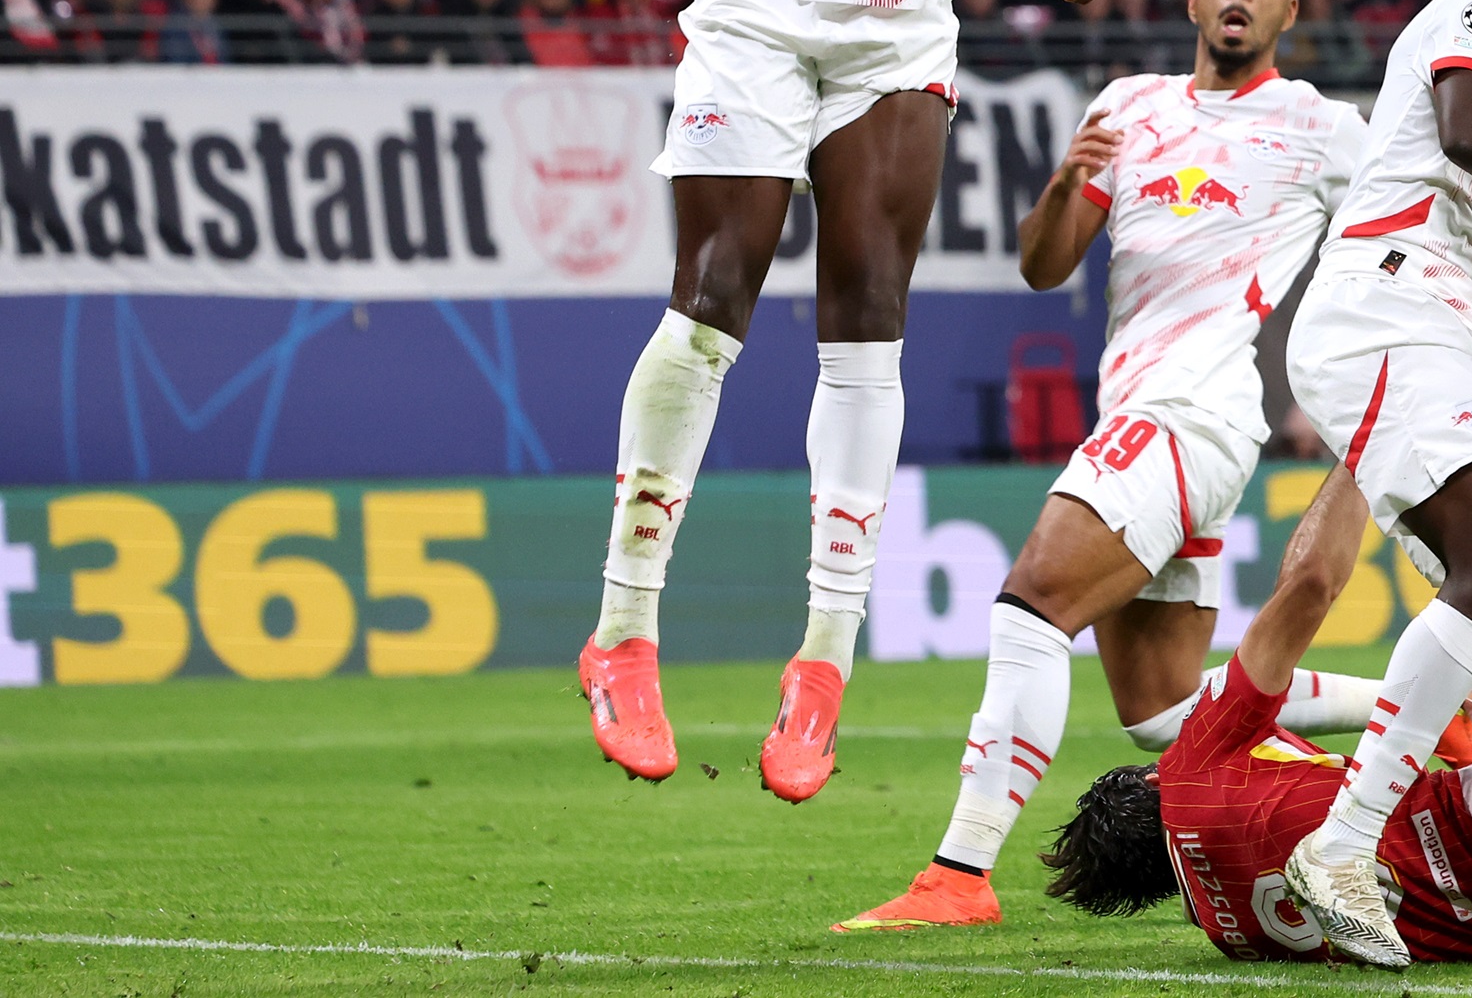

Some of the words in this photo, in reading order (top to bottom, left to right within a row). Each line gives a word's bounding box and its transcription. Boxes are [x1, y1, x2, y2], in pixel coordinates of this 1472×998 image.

[0, 106, 499, 260] katstadt
[634, 525, 660, 541] RBL
[830, 541, 857, 555] RBL
[1419, 815, 1463, 902] oundation
